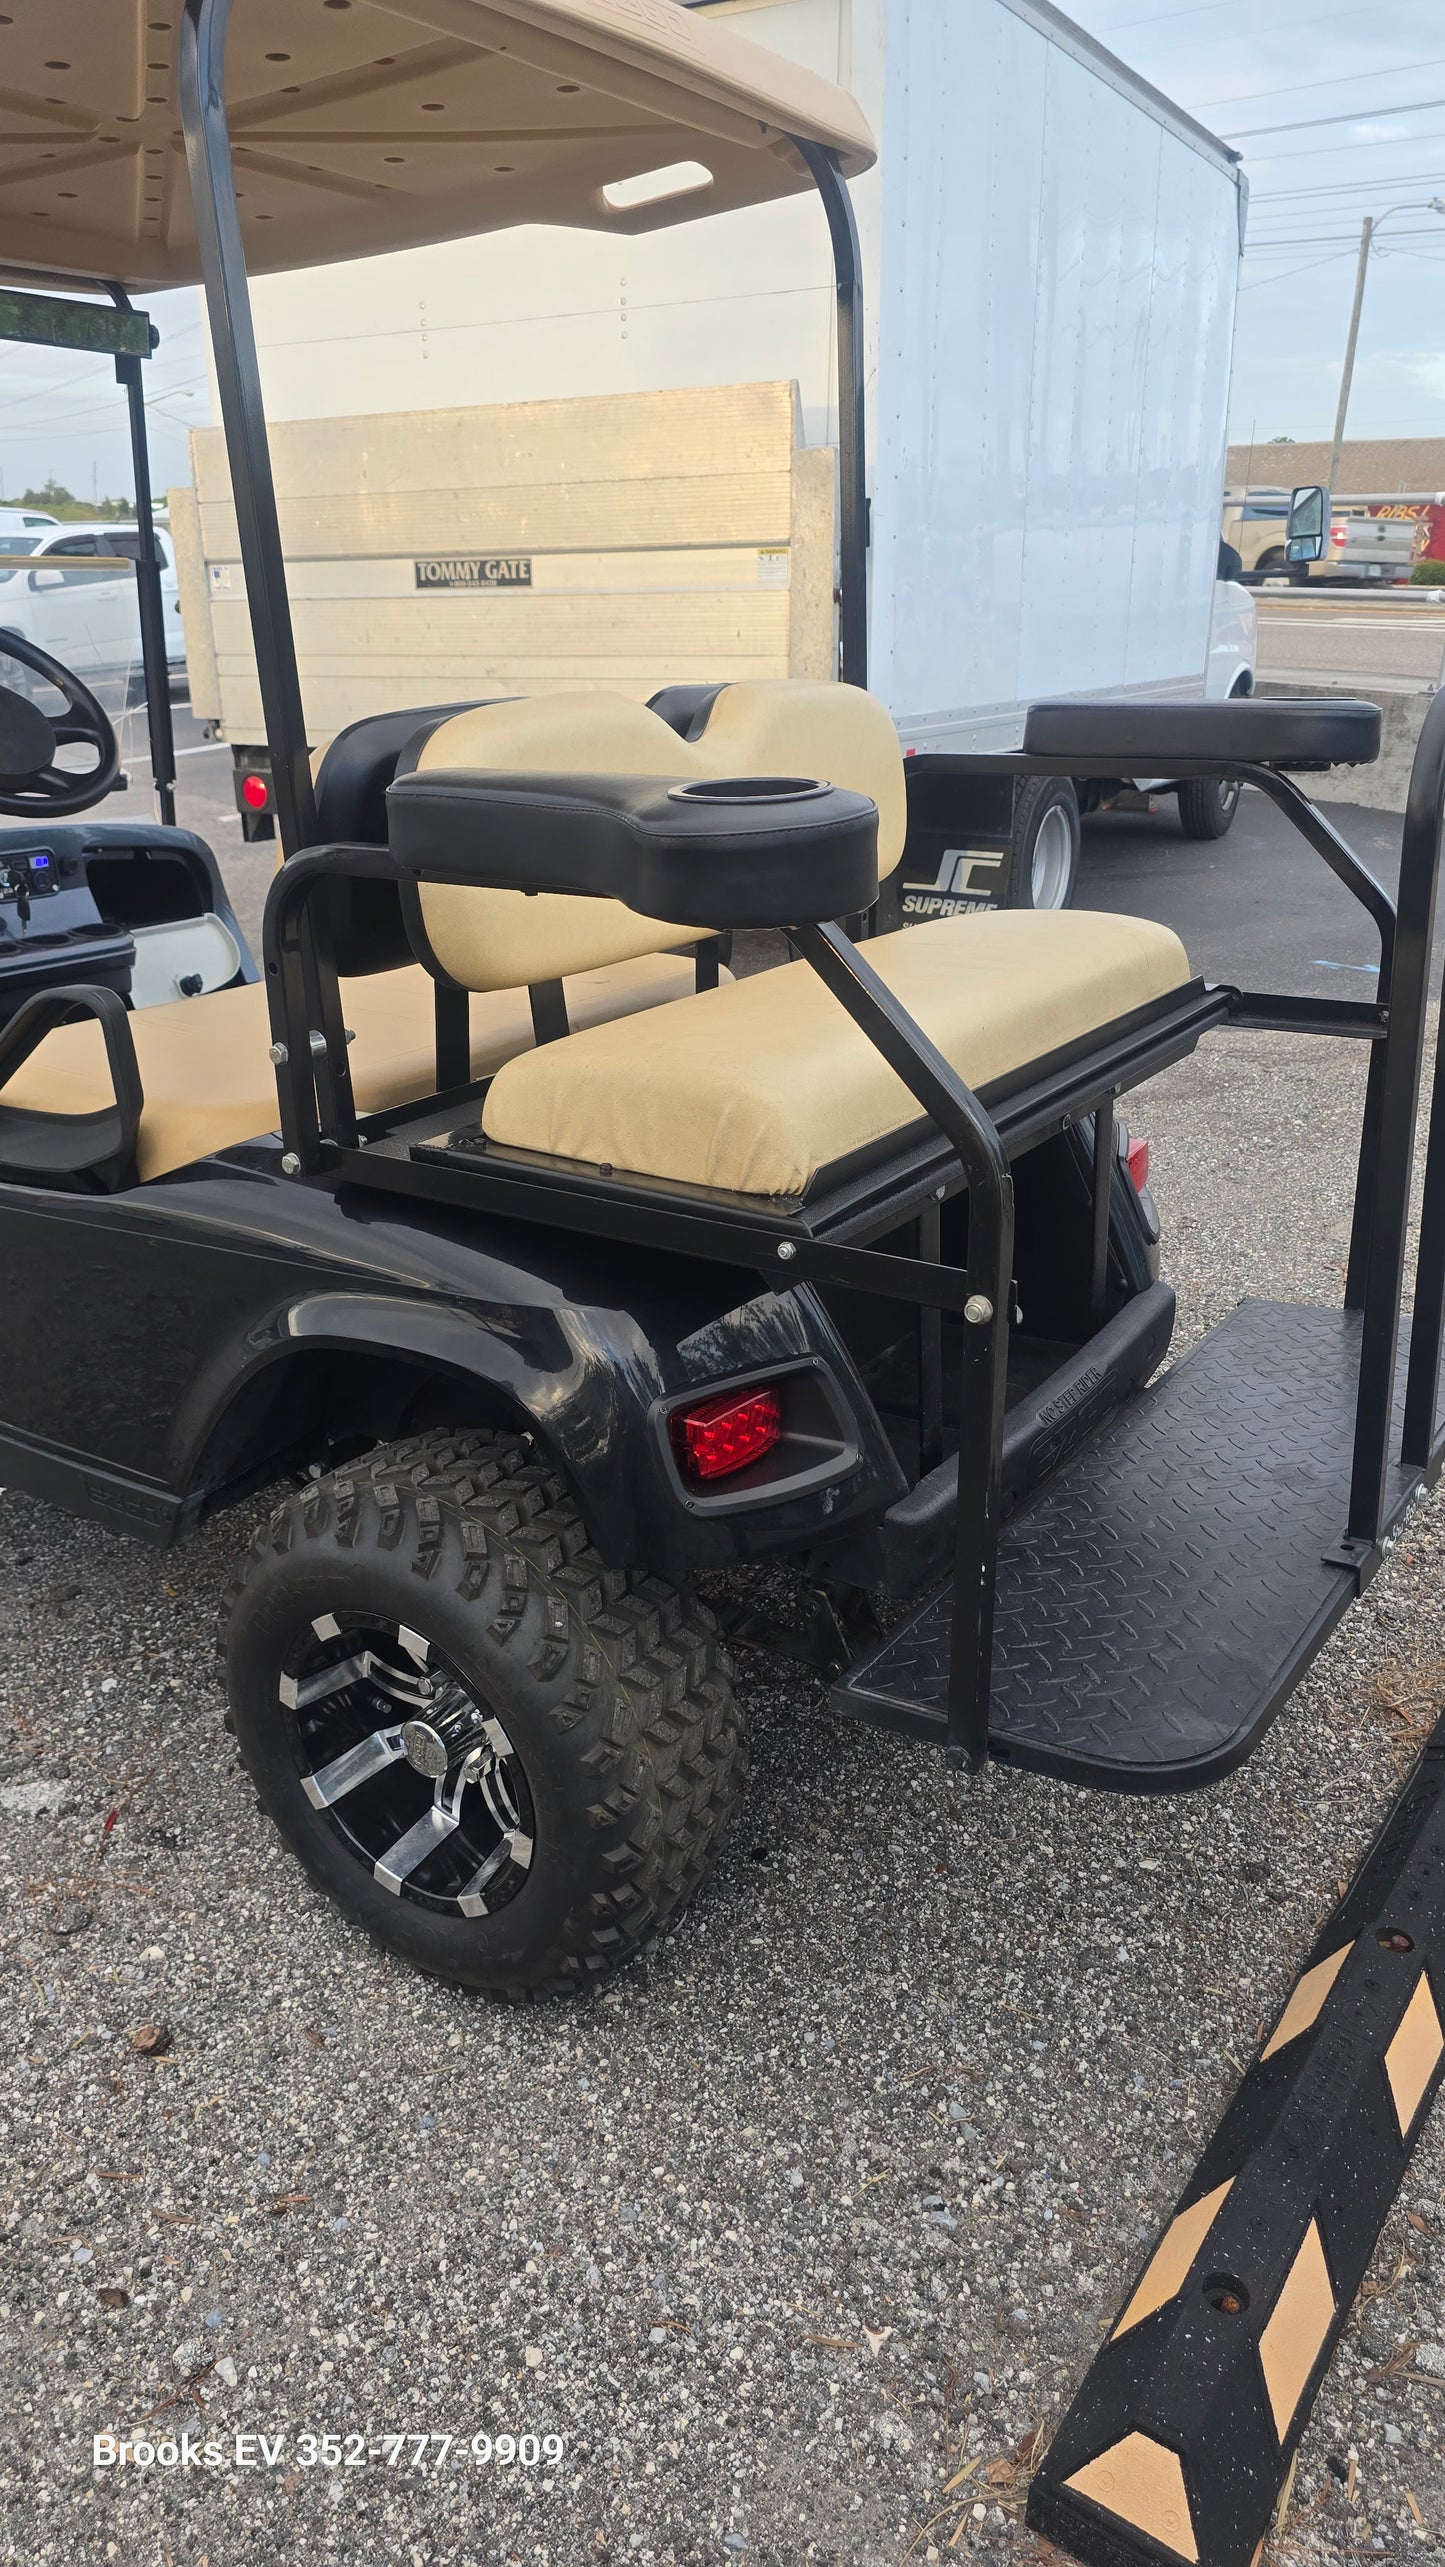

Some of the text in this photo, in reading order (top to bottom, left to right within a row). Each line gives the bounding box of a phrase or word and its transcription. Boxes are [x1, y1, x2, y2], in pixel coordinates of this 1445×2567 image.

[417, 560, 530, 581] TOMMY GATE
[1039, 1404, 1057, 1426] NO
[1074, 1366, 1102, 1397] RIDER
